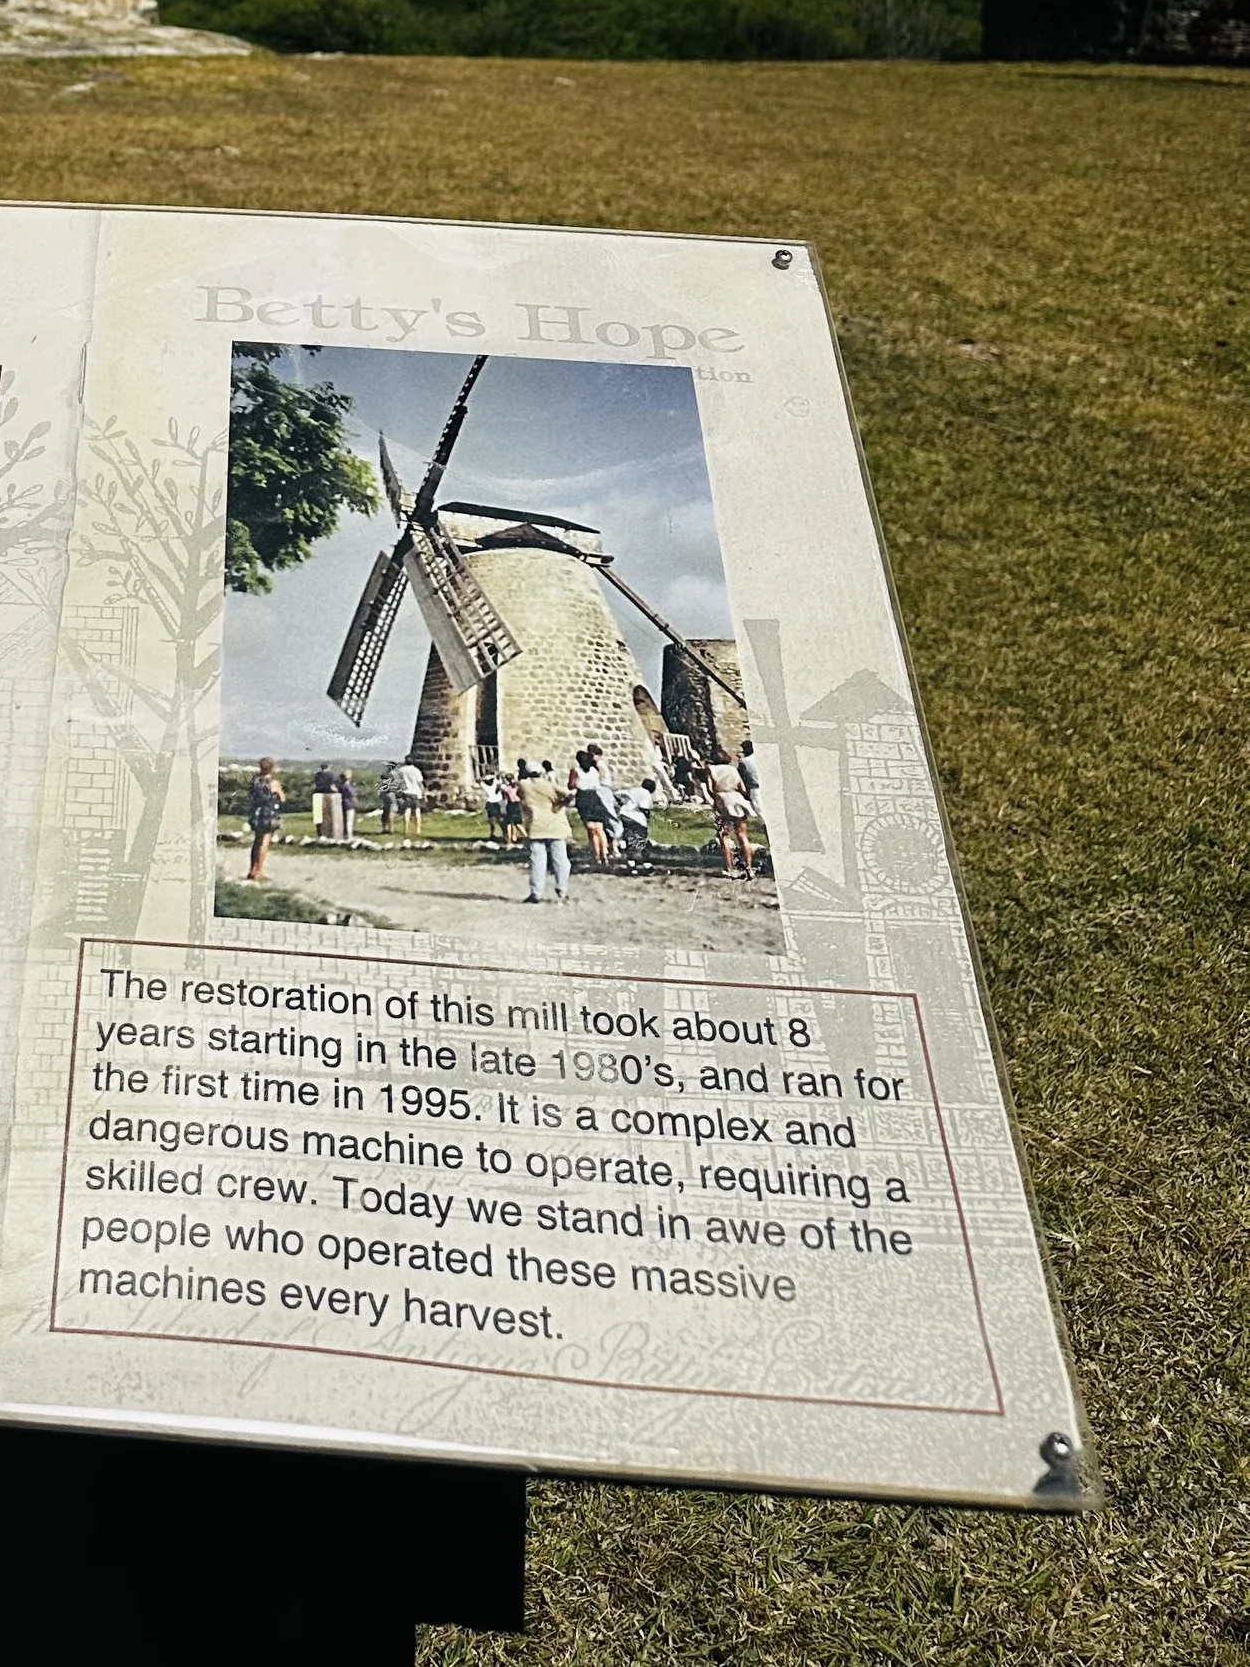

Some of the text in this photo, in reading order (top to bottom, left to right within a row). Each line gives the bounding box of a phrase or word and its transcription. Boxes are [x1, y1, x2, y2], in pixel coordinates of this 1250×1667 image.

[193, 284, 747, 360] Betty's Hope
[100, 968, 811, 1048] The restoration of this mill took about 8
[95, 1021, 195, 1052] years
[208, 1024, 342, 1069] starting
[357, 1032, 387, 1065] in
[398, 1036, 457, 1071] the
[470, 1041, 537, 1077] late
[699, 1062, 769, 1094] and
[782, 1071, 843, 1098] ran
[853, 1067, 905, 1101] for
[92, 1061, 857, 1149] the first time in 1995. It is a complex and
[89, 1109, 911, 1209] dangerous machine to operate, requiring a
[85, 1158, 913, 1256] skilled crew. Today we stand in awe of the
[82, 1213, 796, 1302] people who operated these massive
[79, 1265, 266, 1307] machines
[280, 1283, 390, 1328] every
[404, 1287, 563, 1340] harvest.
